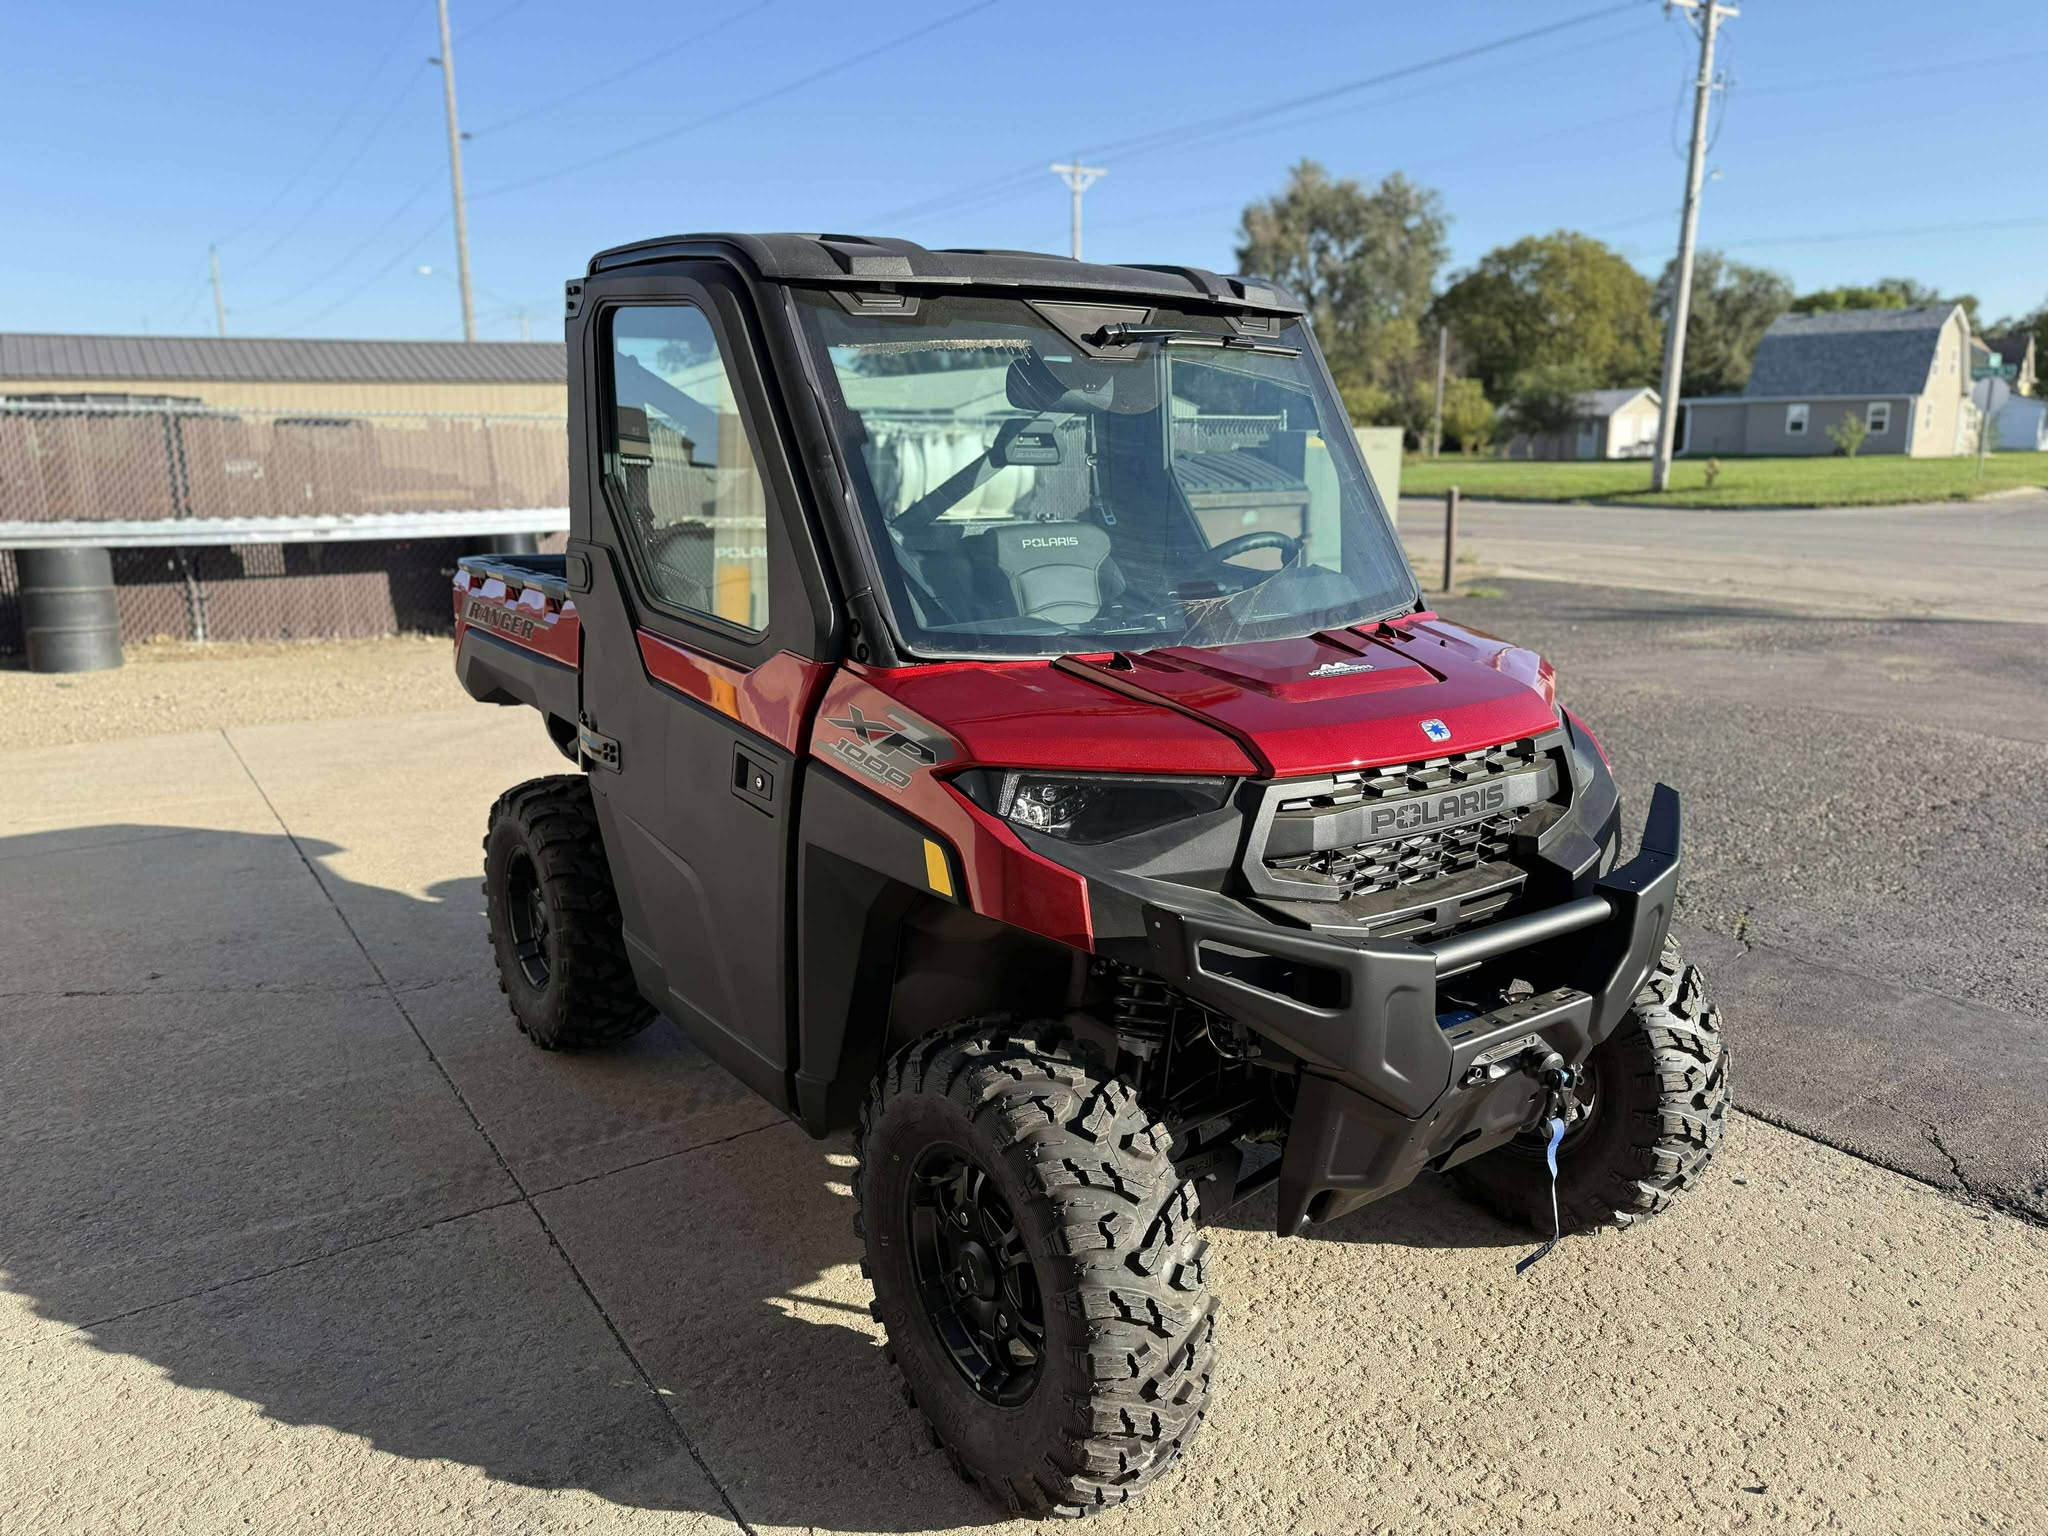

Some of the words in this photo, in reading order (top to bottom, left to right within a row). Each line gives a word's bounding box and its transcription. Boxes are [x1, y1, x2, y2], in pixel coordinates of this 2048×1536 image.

[1021, 536, 1079, 549] POLARIS
[468, 601, 536, 640] RANGER
[823, 702, 937, 766] XP
[836, 736, 913, 789] 1000
[1370, 783, 1505, 835] POLARIS
